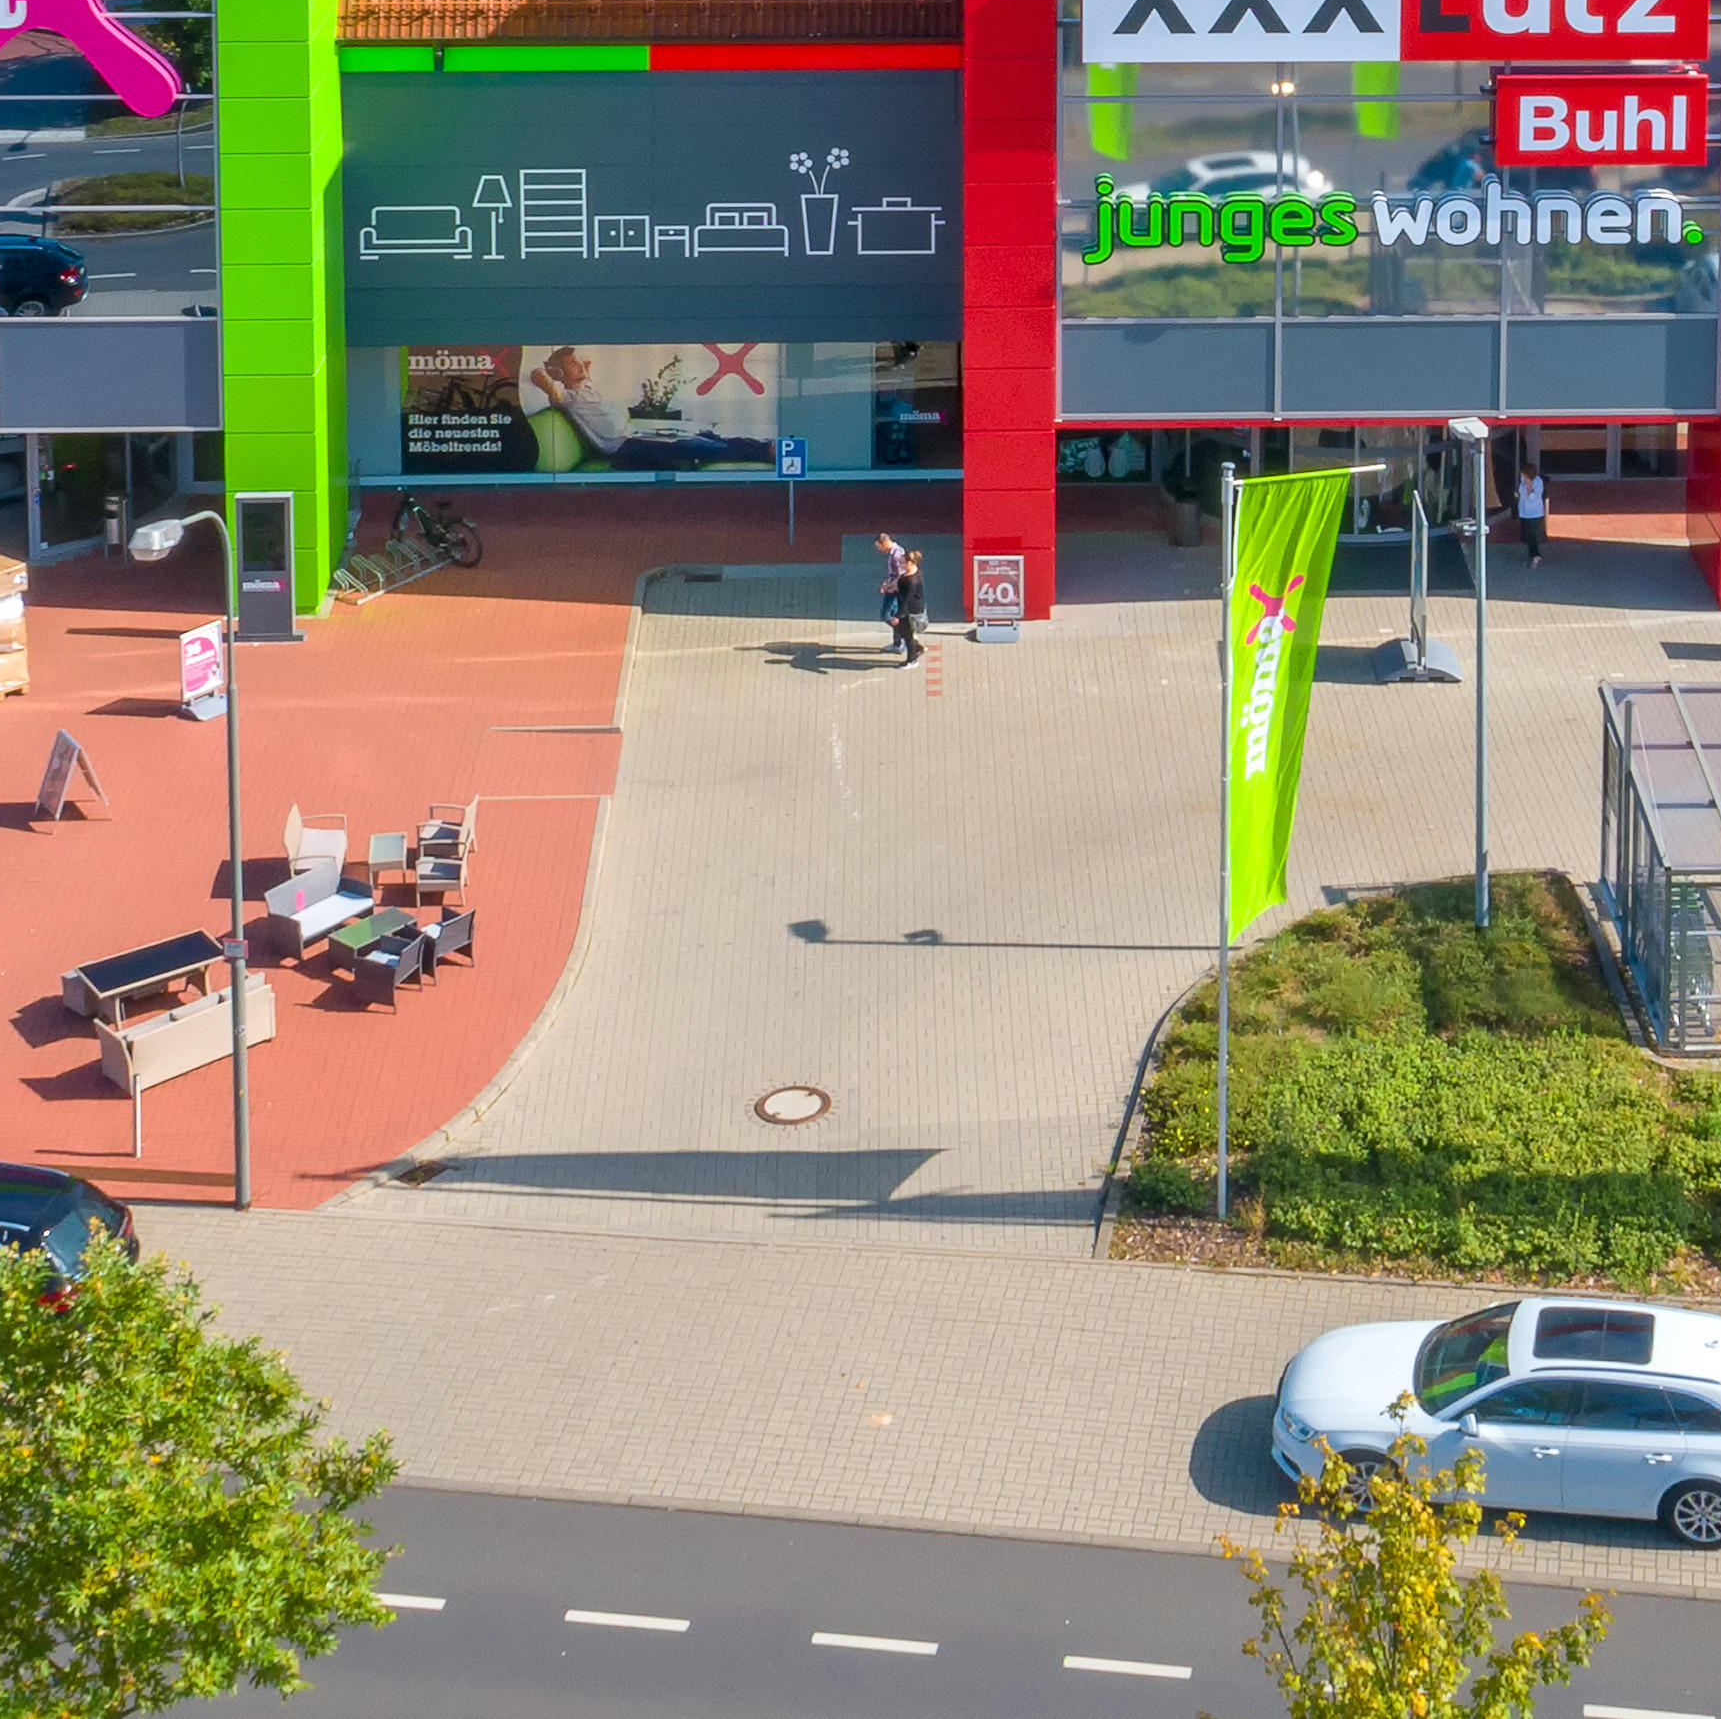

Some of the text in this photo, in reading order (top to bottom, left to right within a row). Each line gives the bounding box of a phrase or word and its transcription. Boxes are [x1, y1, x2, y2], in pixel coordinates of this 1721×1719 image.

[1518, 94, 1688, 152] Buhl
[408, 413, 512, 425] Hier finden Sie
[408, 427, 500, 439] die neuesten
[408, 440, 502, 453] Möbeltrends!
[781, 440, 795, 456] P
